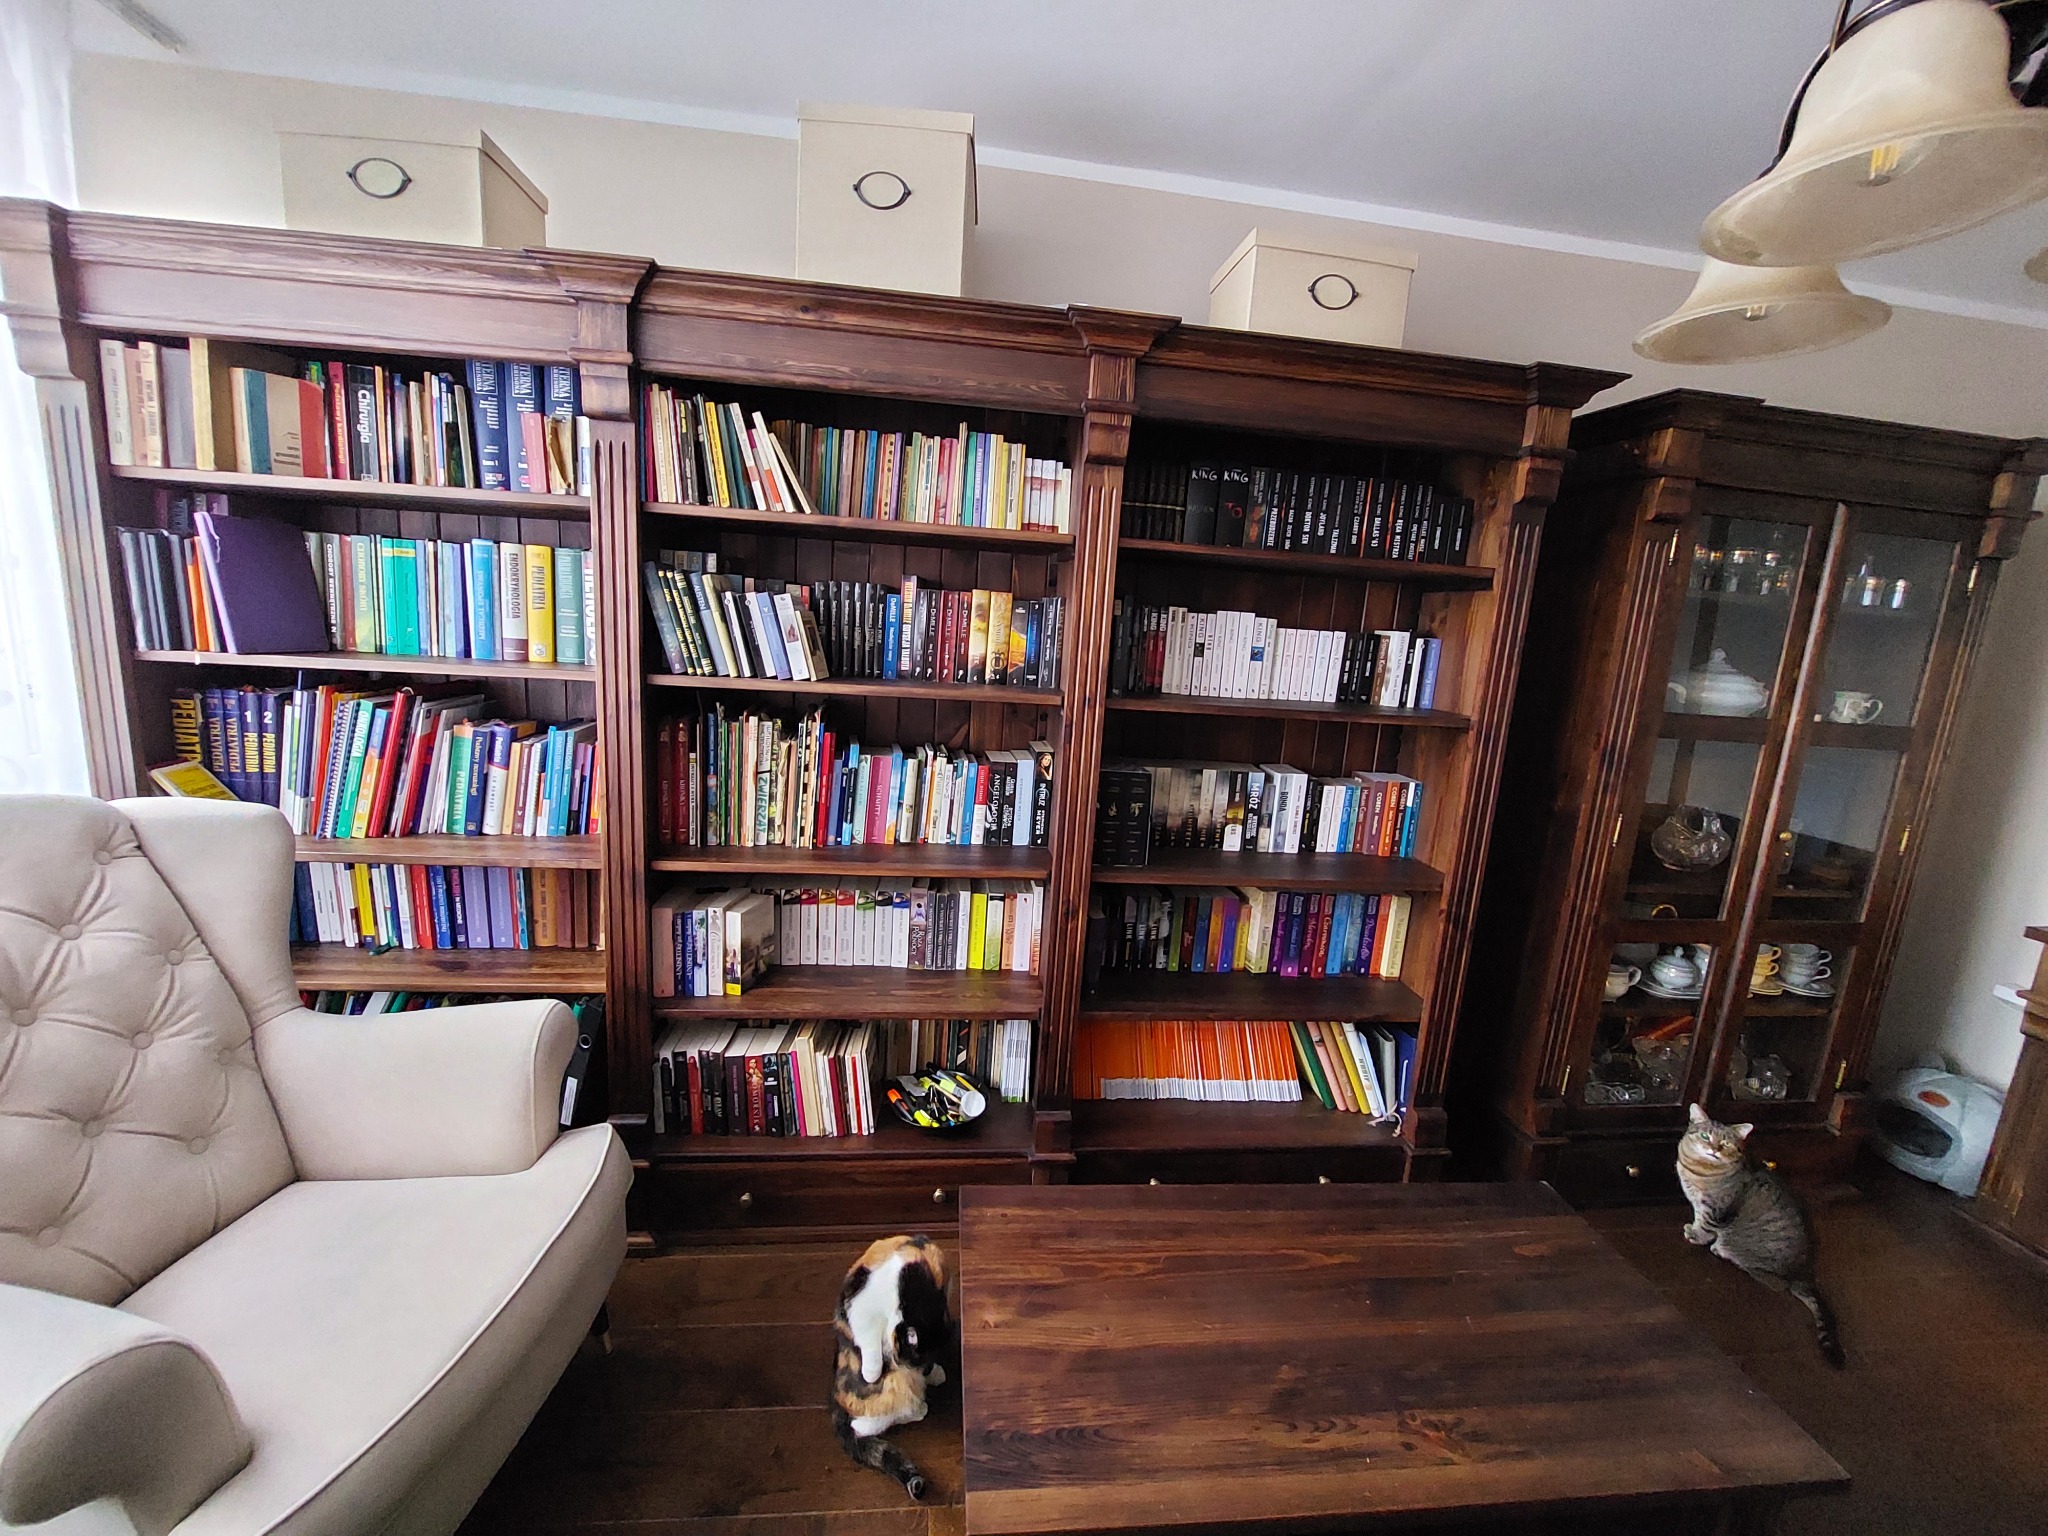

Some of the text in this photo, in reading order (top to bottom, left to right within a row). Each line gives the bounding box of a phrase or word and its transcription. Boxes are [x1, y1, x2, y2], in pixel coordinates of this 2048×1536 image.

[482, 361, 495, 390] TERNA
[520, 364, 532, 394] TERNA
[558, 367, 571, 397] TERNA
[334, 383, 345, 464] Podstawy kardiologii
[356, 390, 372, 443] Chirurgia
[1191, 470, 1217, 481] KING
[1223, 471, 1248, 483] KING
[1267, 508, 1279, 547] PRZEBUDZENIE
[1303, 512, 1312, 531] DOKTOR
[1317, 512, 1327, 536] JOYLAND
[1352, 516, 1360, 534] CZARNY
[1373, 517, 1381, 537] DALLAS
[1395, 519, 1404, 532] RĘKA
[1301, 534, 1309, 544] SEN
[1330, 529, 1340, 554] TALIZMAN
[1371, 539, 1379, 547] '63
[1392, 535, 1401, 558] MISTRZA
[327, 544, 335, 577] CHOROBY
[357, 542, 365, 582] CHOROBY
[509, 553, 520, 619] ENDOKRYNOLOGIA
[532, 566, 546, 610] PEDIATRIA
[558, 556, 574, 599] FARMAKOLOGIA
[694, 585, 706, 610] AUSTEN
[889, 598, 897, 622] DeMILLE
[960, 610, 968, 638] DeMILLE
[1150, 613, 1158, 630] KING
[1255, 623, 1263, 642] KING
[1332, 635, 1344, 670] STEPHEN KING
[1377, 638, 1390, 673] STEPHEN KING
[244, 711, 252, 723] 1
[264, 711, 273, 724] 2
[209, 717, 224, 771] PEDIATRIA
[226, 718, 240, 772] PEDIATRIA
[351, 711, 369, 757] ONKOLOGIA
[244, 732, 259, 772] PEDIATRIA
[262, 733, 276, 772] PEDIATRIA
[494, 737, 503, 762] Pediatria
[452, 771, 465, 819] PEDIATRIA
[757, 777, 768, 833] ZWIERZĄT
[874, 784, 882, 815] SCHMITT
[991, 774, 1000, 830] ANGELOLOGIA
[1038, 783, 1046, 806] INTRUZ
[1248, 783, 1261, 809] MRÓZ
[1279, 791, 1288, 812] BONDA
[1342, 790, 1352, 822] HARLAN COBEN
[1358, 789, 1369, 822] HARLAN COBEN
[1375, 792, 1383, 813] COBEN
[1390, 787, 1398, 807] COBEN
[1399, 789, 1407, 810] COBEN
[1032, 928, 1041, 962] NIEWOLNICA
[1125, 924, 1133, 939] LINK
[1138, 924, 1146, 940] LINK
[1150, 924, 1158, 940] LINK
[751, 1083, 760, 1123] OMORNIK
